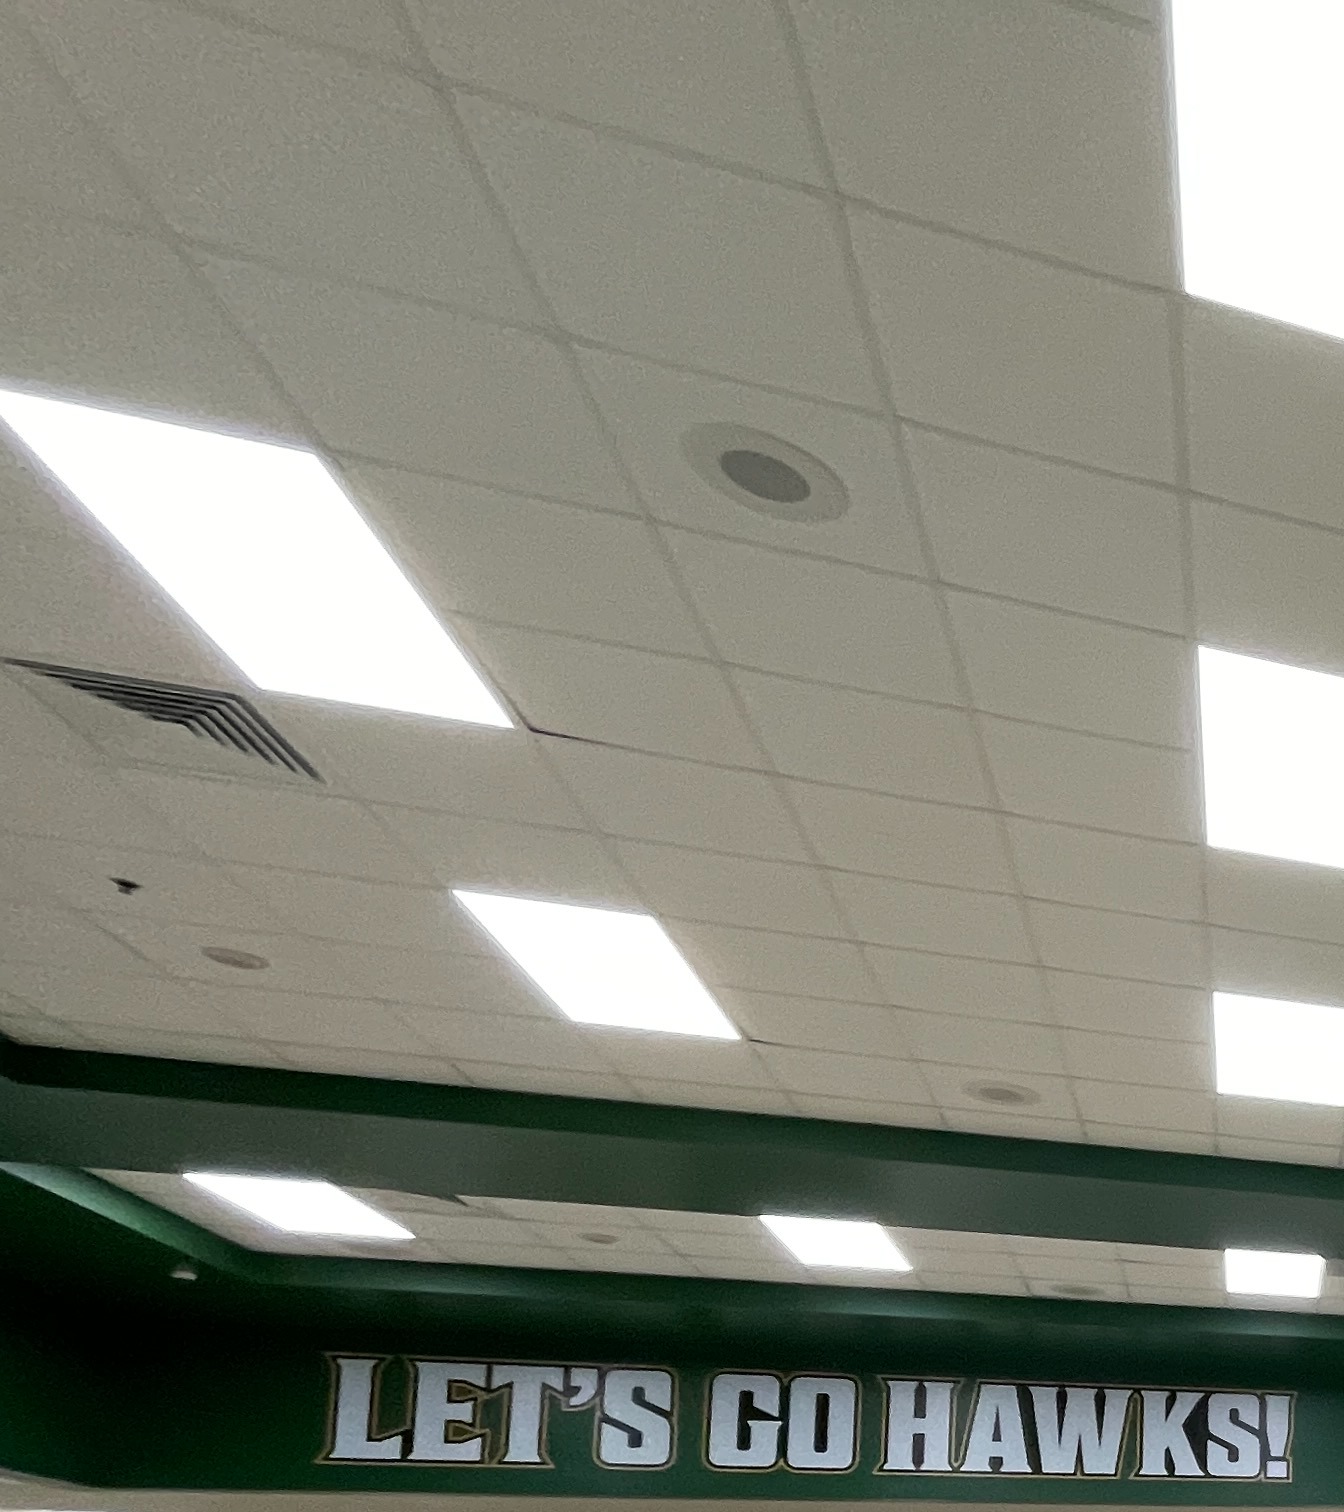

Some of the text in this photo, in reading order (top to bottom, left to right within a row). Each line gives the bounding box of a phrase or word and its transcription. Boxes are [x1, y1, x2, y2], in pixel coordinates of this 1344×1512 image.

[319, 1354, 1295, 1481] LET'S GO HAWKS!
